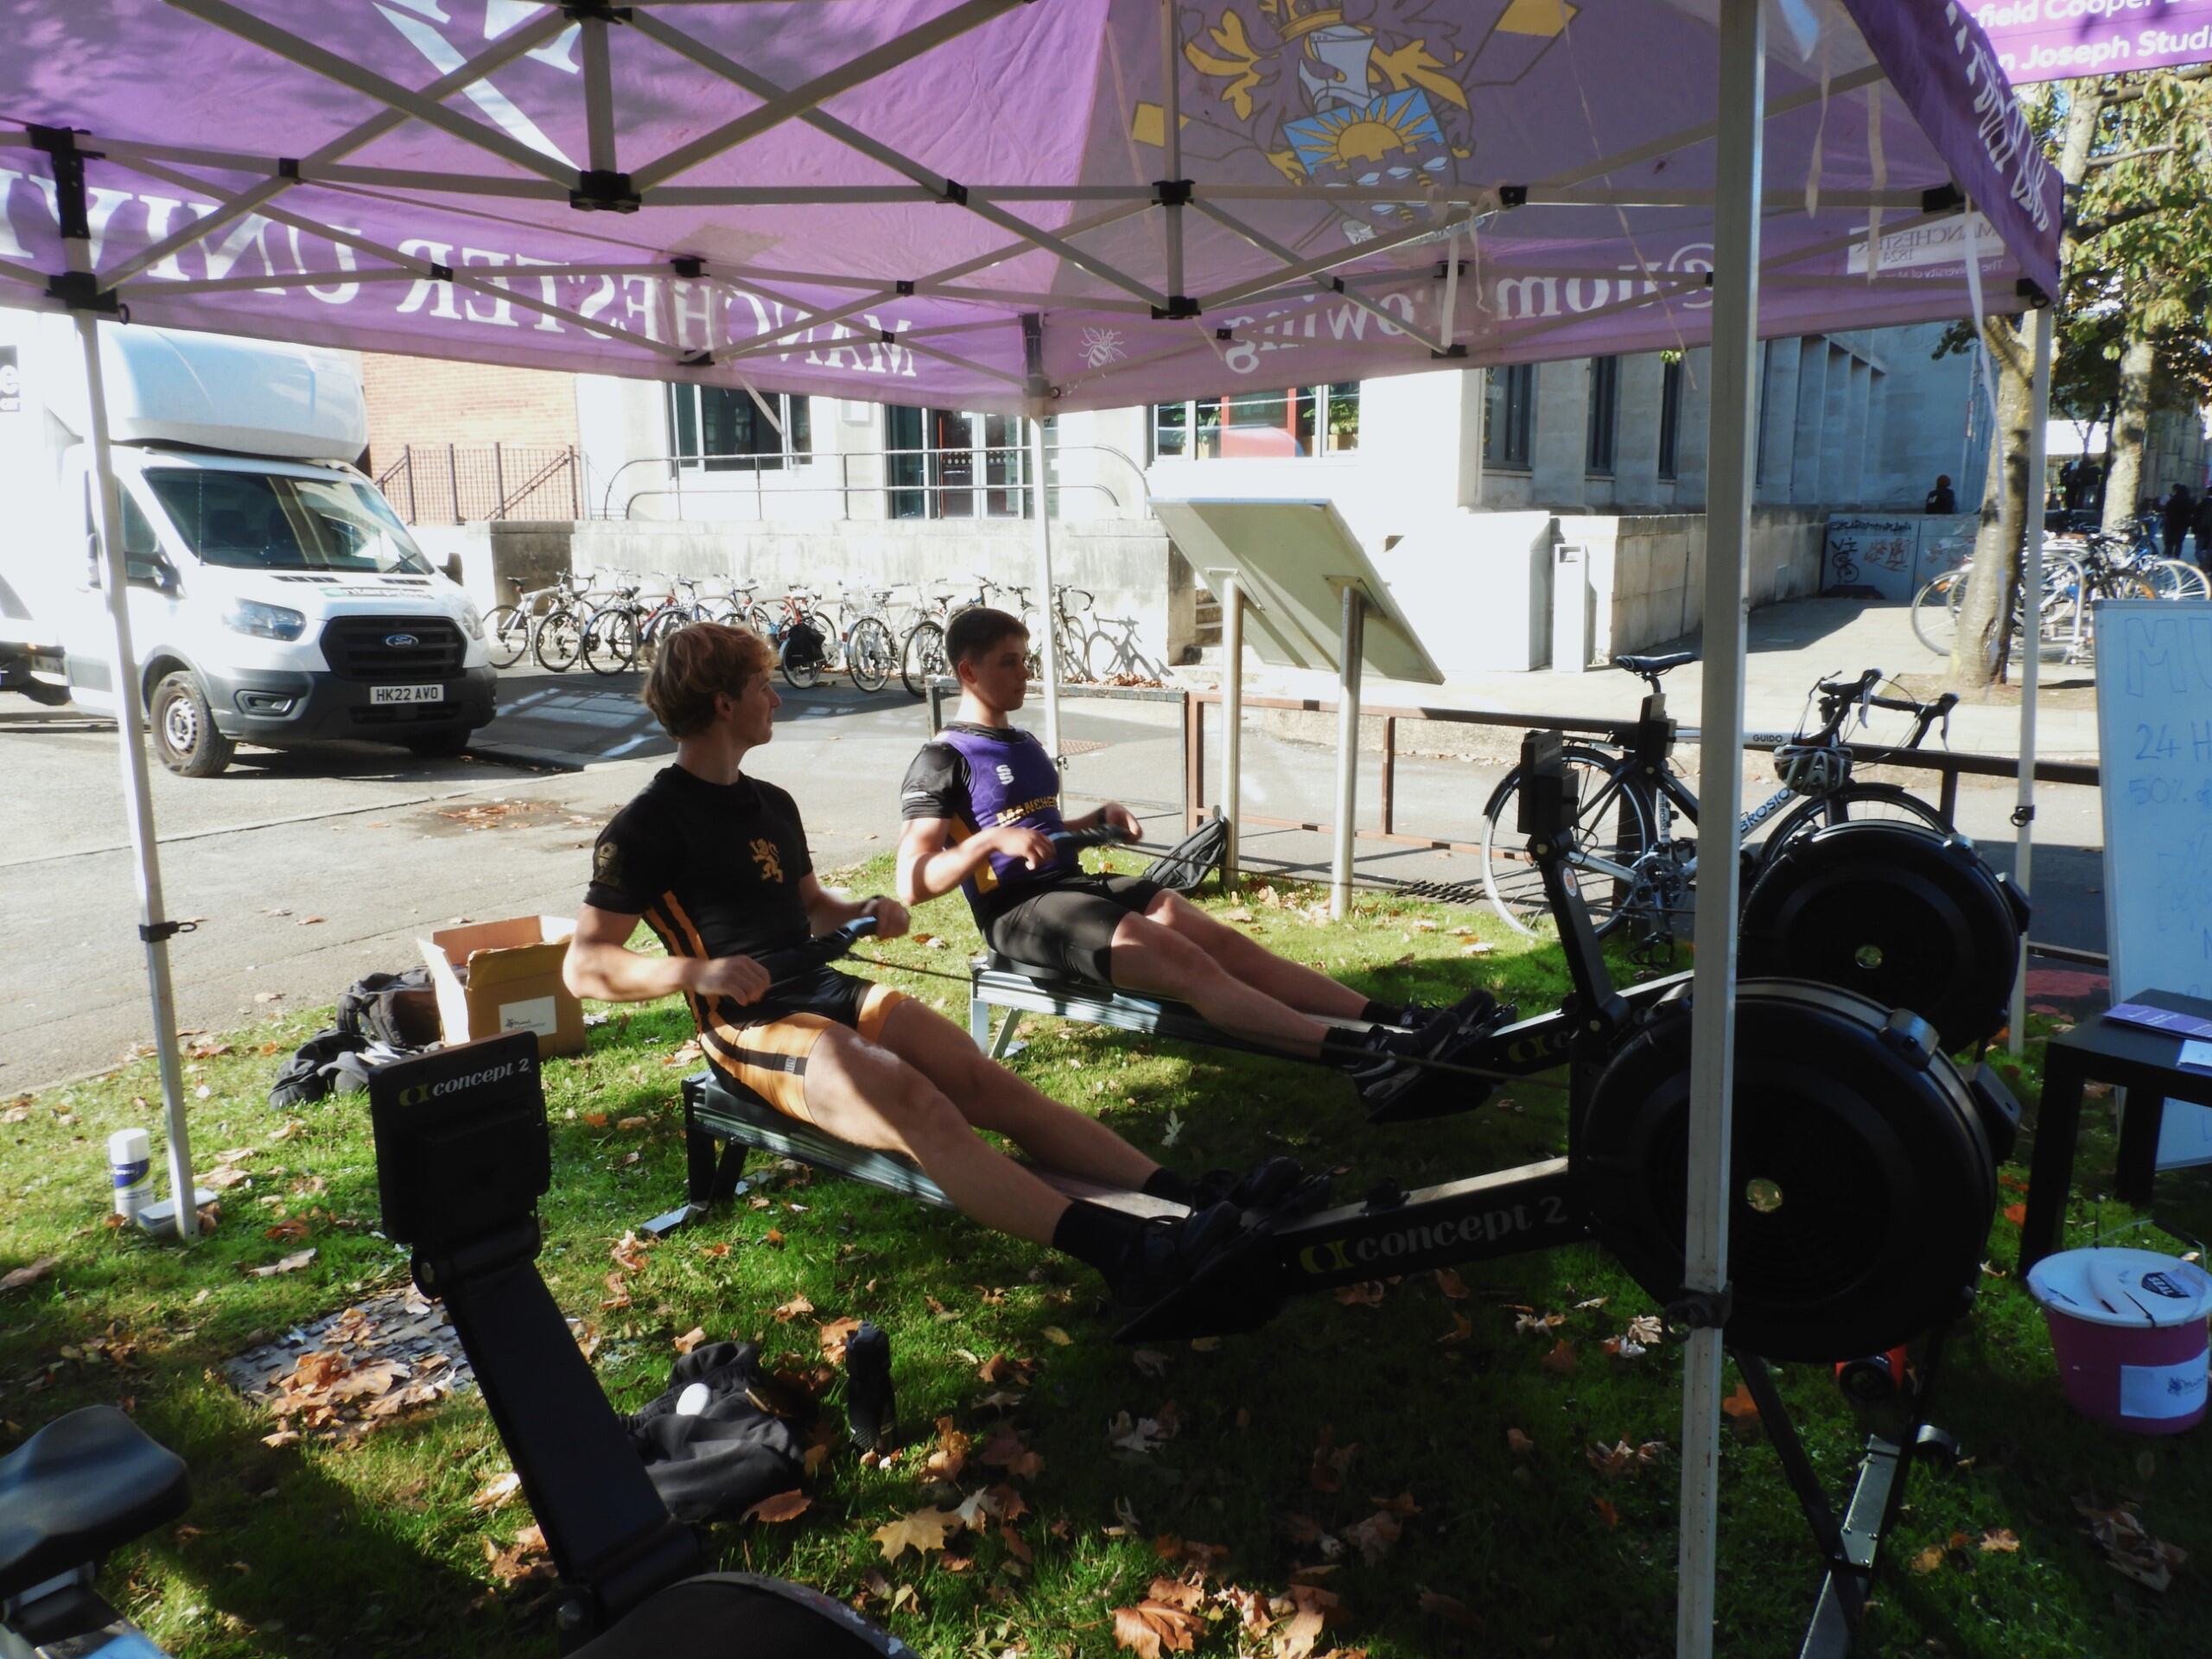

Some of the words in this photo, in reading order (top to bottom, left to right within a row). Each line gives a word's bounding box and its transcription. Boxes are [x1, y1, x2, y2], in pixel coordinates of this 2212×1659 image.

[1971, 0, 2038, 28] field
[2020, 35, 2130, 70] Joseph
[377, 688, 411, 702] HK22
[415, 687, 438, 700] AVO
[1752, 734, 1783, 743] GUIDO
[2135, 722, 2182, 760] 24
[432, 1062, 514, 1096] concept
[518, 1058, 530, 1072] 2
[1356, 1204, 1533, 1262] concept
[1538, 1196, 1569, 1225] 2
